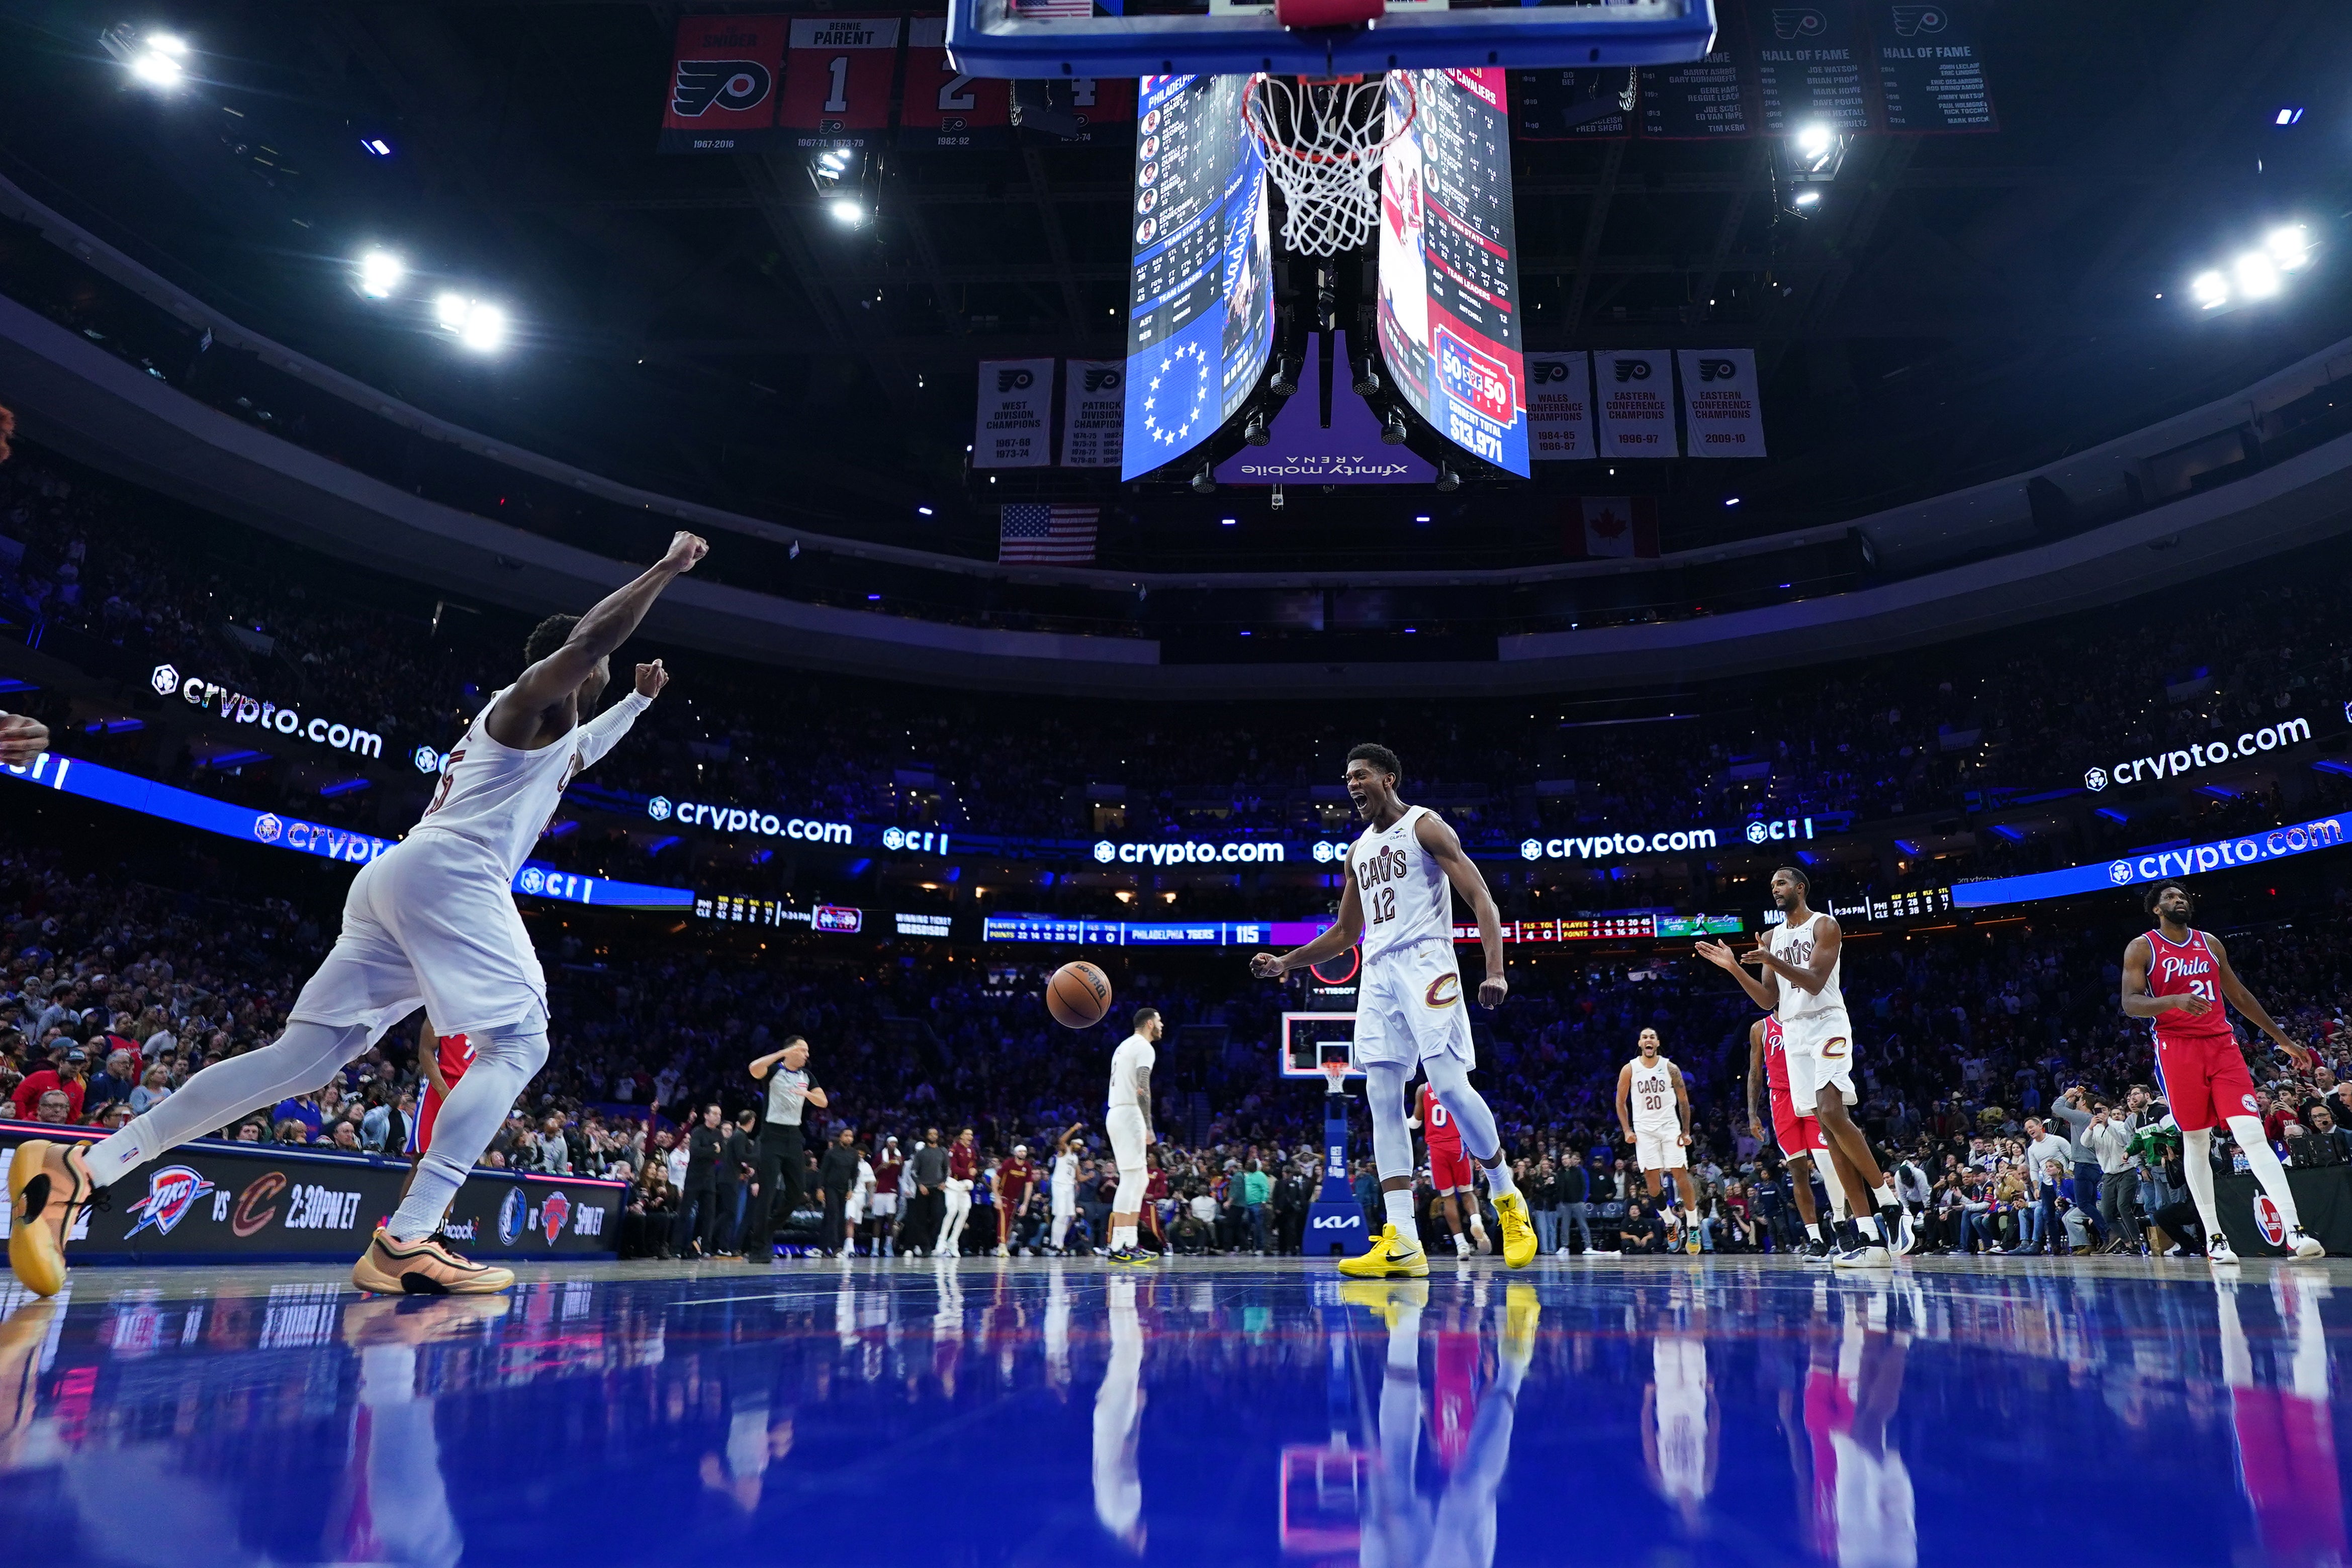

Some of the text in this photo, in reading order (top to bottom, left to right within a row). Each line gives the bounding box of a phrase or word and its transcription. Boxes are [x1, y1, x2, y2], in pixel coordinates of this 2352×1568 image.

[830, 22, 861, 30] BERNIE
[703, 34, 757, 47] SNIDER
[813, 31, 874, 45] PARENT
[1762, 49, 1850, 61] HALL OF FAME
[1883, 46, 1972, 58] HALL OF FAME
[1825, 65, 1858, 73] WATSON
[825, 57, 848, 112] 1
[1457, 69, 1496, 105] CAVALIERS
[1839, 86, 1861, 95] HOWE
[1163, 96, 1184, 115] MAXEY
[1162, 121, 1185, 141] GEORGE
[693, 140, 734, 148] 1967-2016
[833, 139, 864, 147] 1973-79
[937, 136, 969, 145] 1982-92
[1159, 196, 1194, 224] EDGECOMBE
[1163, 218, 1201, 248] TEAM STATS
[1447, 215, 1484, 245] TEAM STATS
[1495, 258, 1504, 267] FLS
[1433, 269, 1443, 282] AST
[1481, 271, 1490, 281] 3PT
[1497, 266, 1504, 275] 15
[1158, 269, 1203, 303] TEAM LEADERS
[1446, 266, 1490, 301] TEAM LEADERS
[1497, 287, 1506, 296] 50
[1139, 315, 1153, 328] AST
[1499, 314, 1507, 324] 12
[1139, 329, 1151, 342] REB
[1468, 356, 1498, 379] Foundation
[1443, 348, 1462, 380] 50
[1484, 376, 1506, 405] 50
[1537, 394, 1568, 402] WALES
[1614, 392, 1656, 401] EASTERN
[1700, 392, 1741, 400] EASTERN
[1002, 401, 1028, 410] WEST
[1082, 402, 1121, 410] PATRICK
[1526, 402, 1583, 412] CONFERENCE
[1606, 402, 1665, 410] CONFERENCE
[1692, 401, 1752, 409] CONFERENCE
[994, 410, 1034, 419] DIVISION
[1081, 411, 1121, 419] DIVISION
[1449, 399, 1502, 438] CURRENT TOTAL
[1527, 412, 1582, 421] CHAMPIONS
[1608, 410, 1665, 419] CHAMPIONS
[1695, 410, 1751, 419] CHAMPIONS
[986, 420, 1041, 429] CHAMPIONS
[1074, 420, 1123, 428] CHAMPION
[1450, 413, 1503, 463] $13,971
[1538, 431, 1575, 440] 1984-85
[1618, 434, 1659, 443] 1996-97
[1705, 433, 1746, 443] 2009-10
[1539, 442, 1575, 451] 1986-87
[996, 449, 1029, 458] 1973-74
[1241, 465, 1408, 476] xfinity mobile
[184, 677, 382, 759] crypto.com
[2114, 717, 2312, 785] crypto.com
[677, 801, 853, 845] crypto.com
[1547, 828, 1716, 859] crypto.com
[2139, 817, 2343, 881] crypto.com
[1119, 841, 1284, 865] crypto.com
[1359, 850, 1407, 890] CAVS
[1373, 887, 1395, 925] 12
[1834, 905, 1865, 916] 9:34 PM
[1873, 902, 1887, 910] PHI
[1892, 900, 1902, 908] 37
[1874, 910, 1888, 919] CLE
[1132, 930, 1215, 940] PHILADELPHIA 76ERS
[1236, 926, 1259, 943] 115
[1526, 931, 1552, 940] 4 0
[1628, 928, 1639, 936] 39
[2162, 956, 2210, 983] Phila
[1075, 964, 1106, 1000] Wilson
[2189, 980, 2216, 1001] 21
[1638, 1080, 1665, 1093] CAVS
[1646, 1095, 1661, 1110] 20
[1431, 1104, 1447, 1127] 0
[342, 1192, 361, 1230] ET
